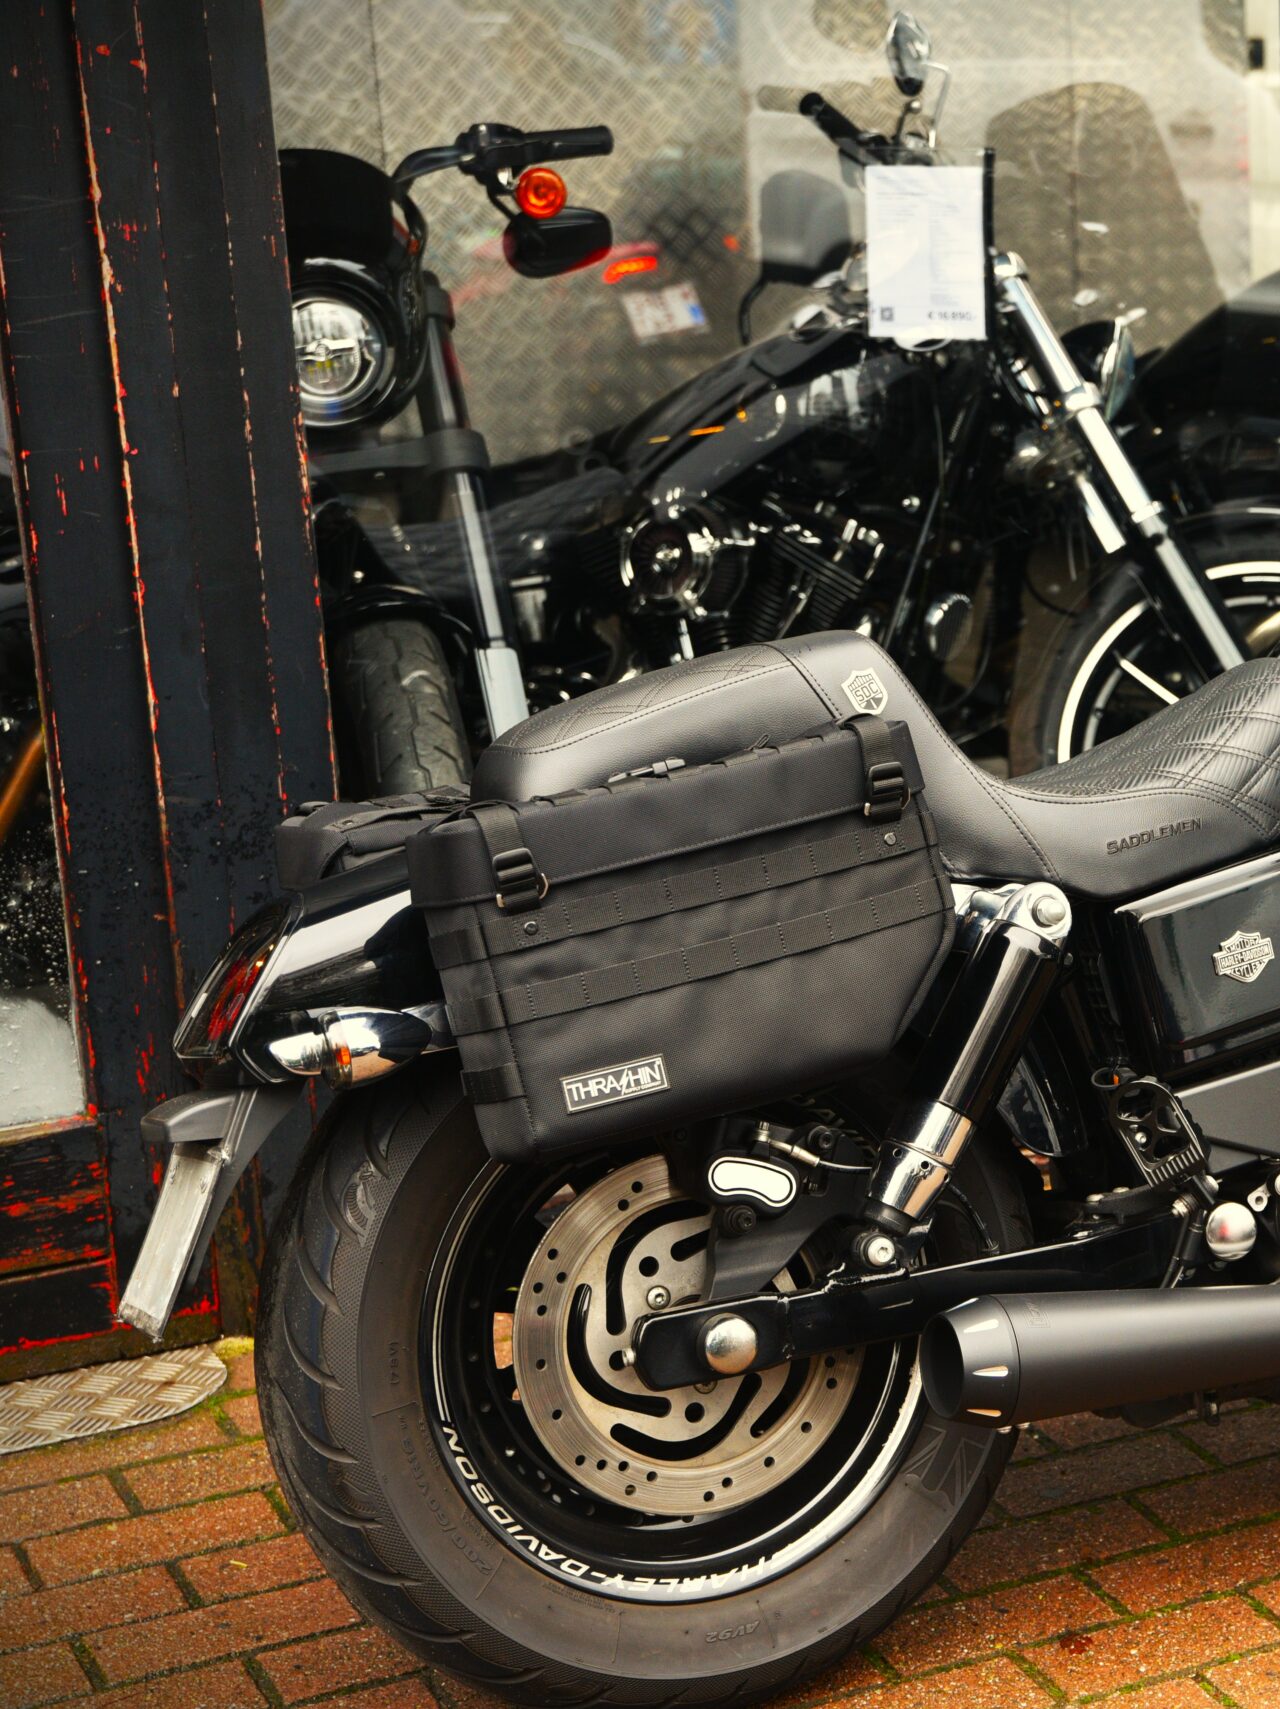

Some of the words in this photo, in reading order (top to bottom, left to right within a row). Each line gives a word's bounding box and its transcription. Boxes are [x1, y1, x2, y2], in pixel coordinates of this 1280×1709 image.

[854, 681, 880, 702] SDC
[1106, 818, 1201, 855] SADDLEMEN
[1220, 943, 1271, 969] HARLEY-DAVIDSON
[1229, 938, 1259, 952] MOTOR
[442, 1425, 767, 1594] HARLEY-DAVIDSON
[705, 1620, 760, 1644] AV92
